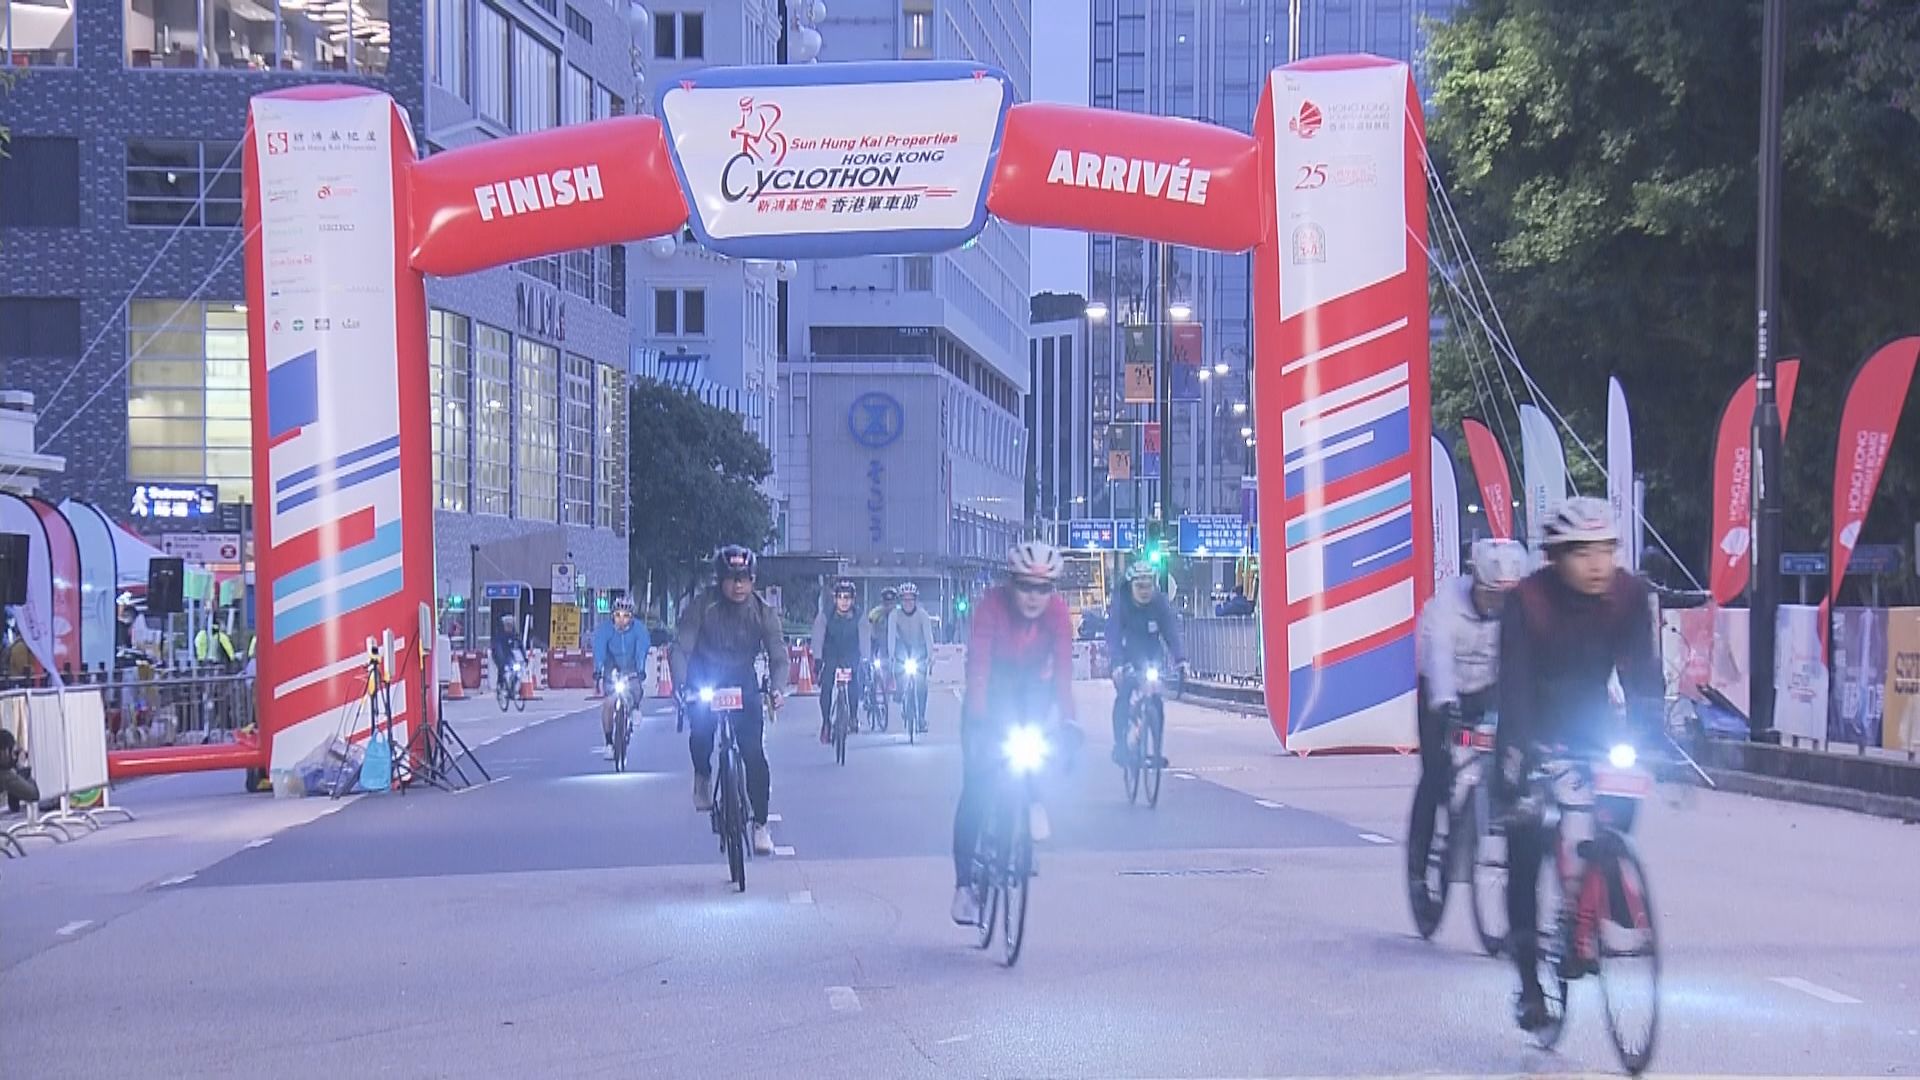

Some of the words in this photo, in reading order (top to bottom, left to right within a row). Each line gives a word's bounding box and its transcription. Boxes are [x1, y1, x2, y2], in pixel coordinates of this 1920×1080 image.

[790, 138, 817, 150] Sun
[820, 137, 856, 151] Hung
[859, 136, 882, 148] Kai
[884, 133, 959, 150] Properties
[841, 153, 892, 166] HONG
[894, 150, 945, 164] KONG
[474, 164, 604, 222] FINISH
[1047, 148, 1211, 206] ARRIVÉE
[1295, 164, 1329, 190] 25
[1733, 447, 1745, 483] KONG
[1854, 430, 1868, 470] KONG
[1848, 471, 1864, 513] HONG
